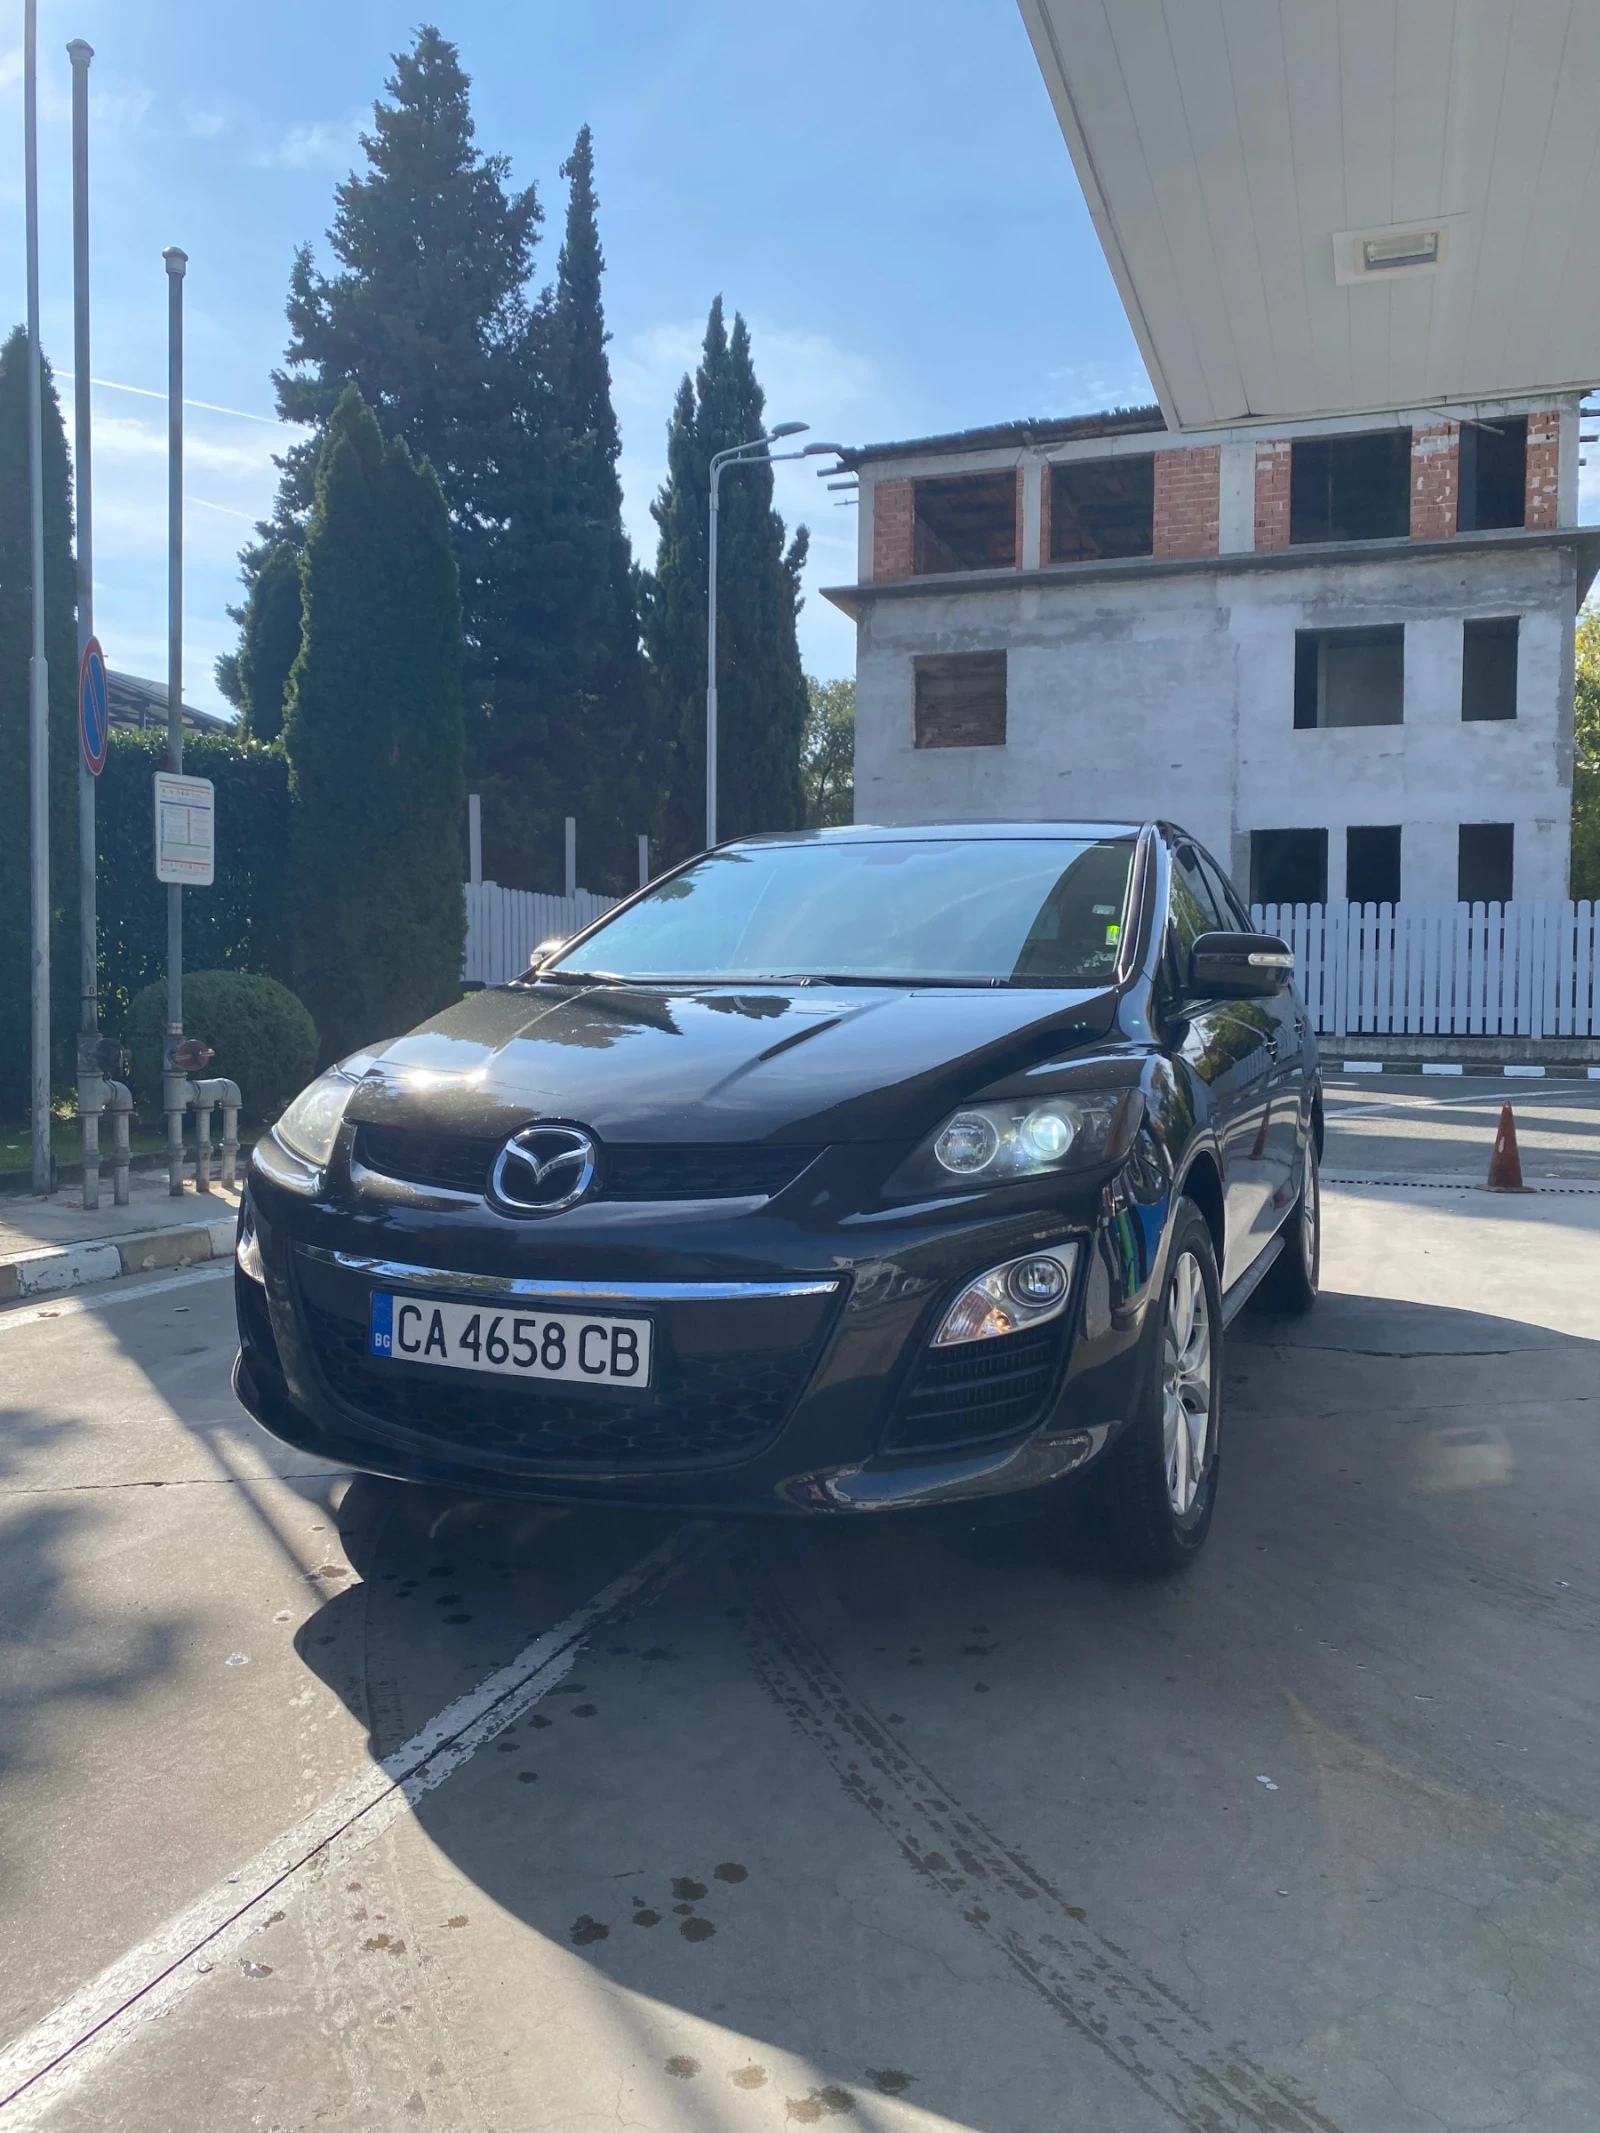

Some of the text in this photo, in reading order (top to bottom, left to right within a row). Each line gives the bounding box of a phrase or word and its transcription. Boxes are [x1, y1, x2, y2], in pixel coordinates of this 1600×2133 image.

[374, 1332, 391, 1348] BG
[398, 1304, 640, 1377] CA 4658 CB
